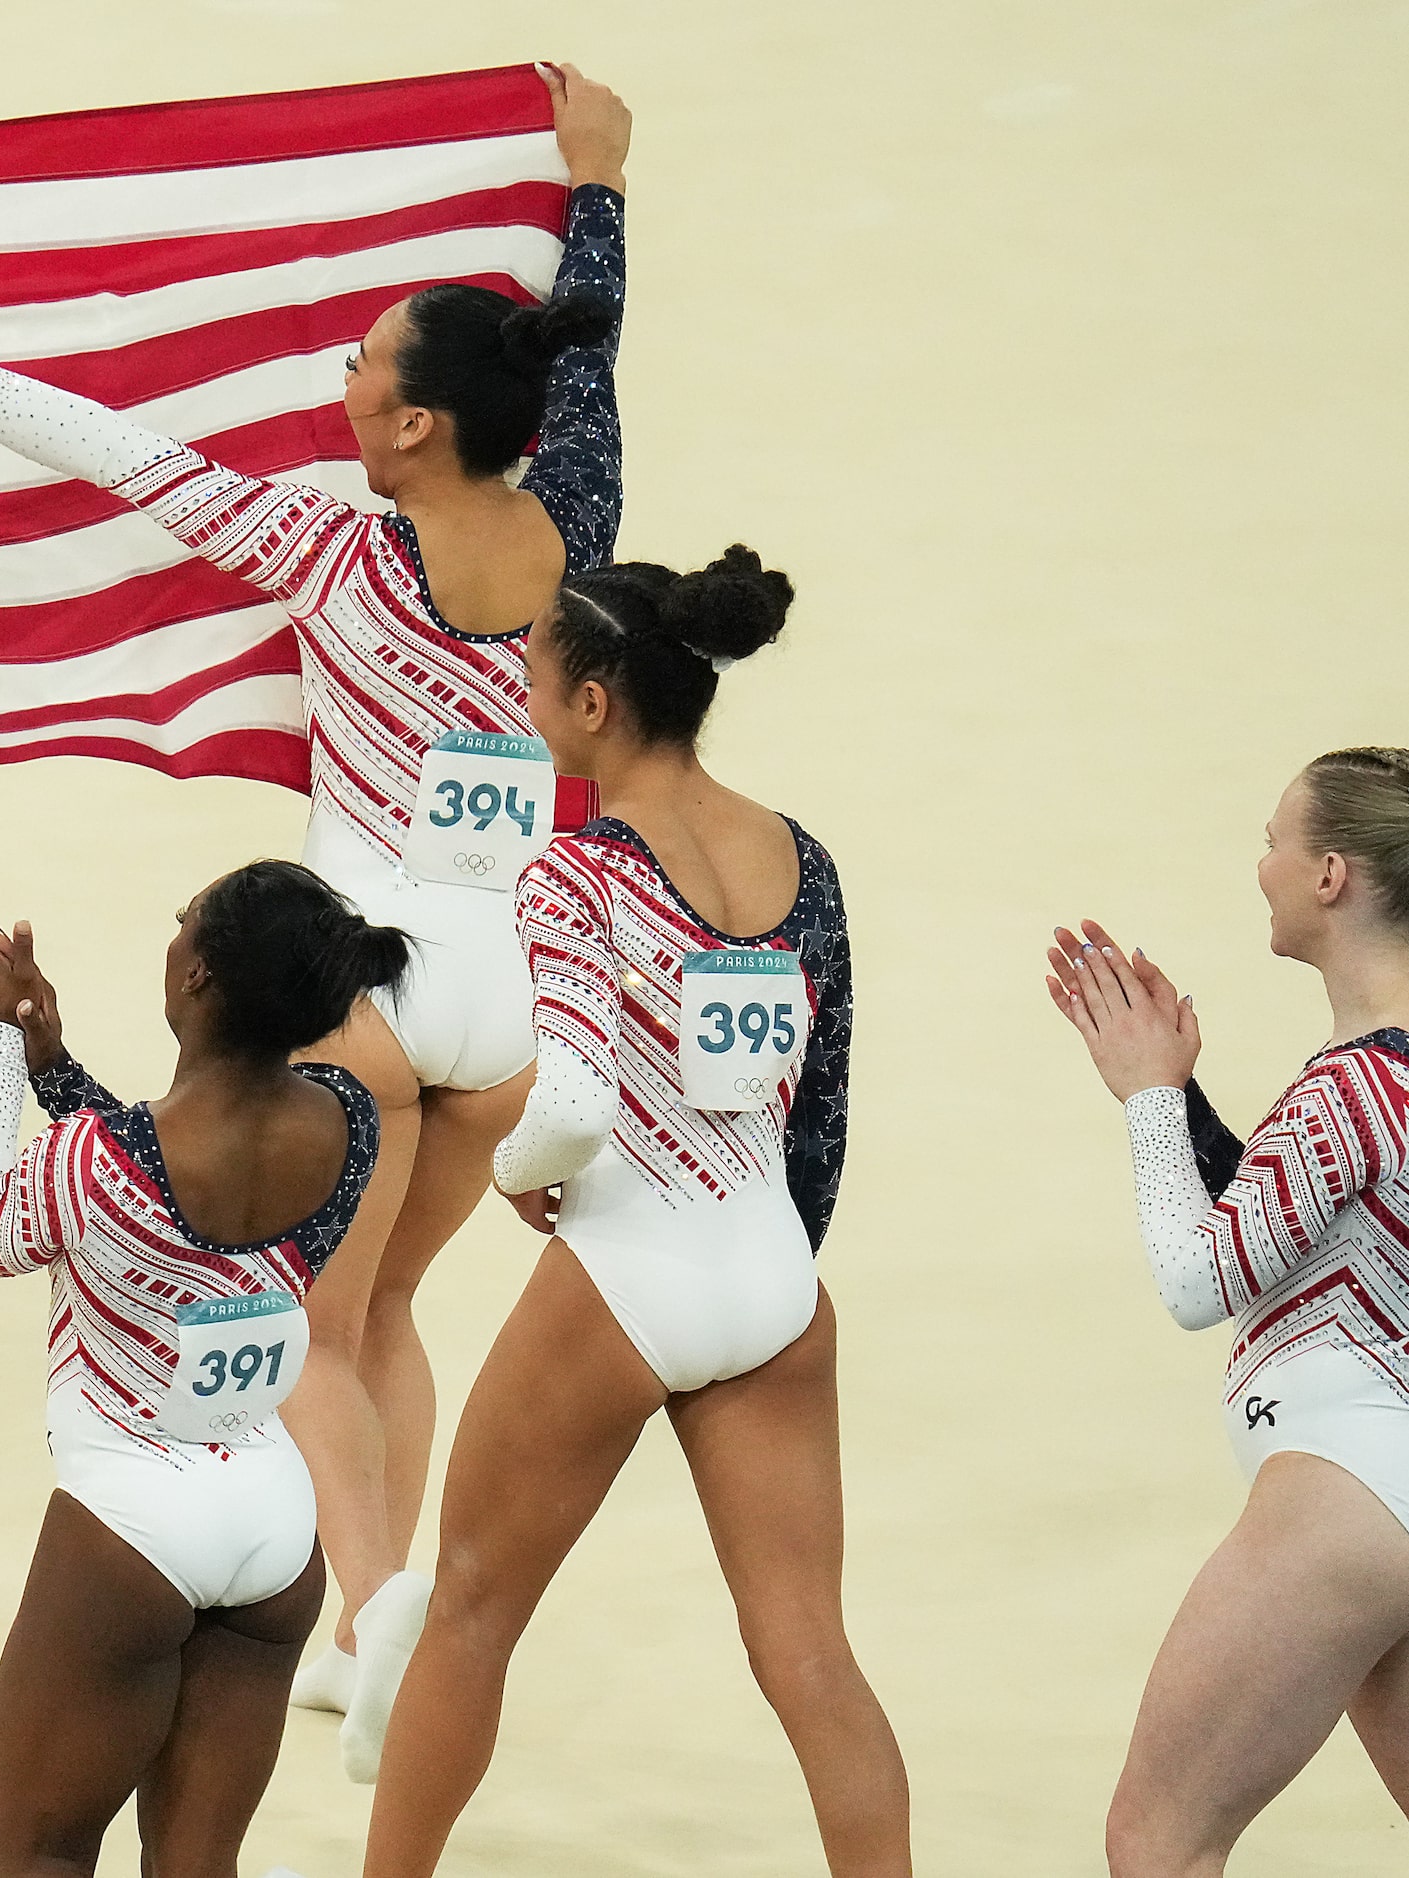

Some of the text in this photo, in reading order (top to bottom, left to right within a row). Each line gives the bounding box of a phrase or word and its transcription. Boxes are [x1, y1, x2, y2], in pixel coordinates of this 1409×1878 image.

[458, 735, 535, 754] PARIS 2024
[429, 779, 535, 837] 394
[716, 955, 787, 968] PARIS 2024
[697, 1001, 796, 1055] 395
[209, 1302, 248, 1317] PARIS
[192, 1339, 285, 1397] 391
